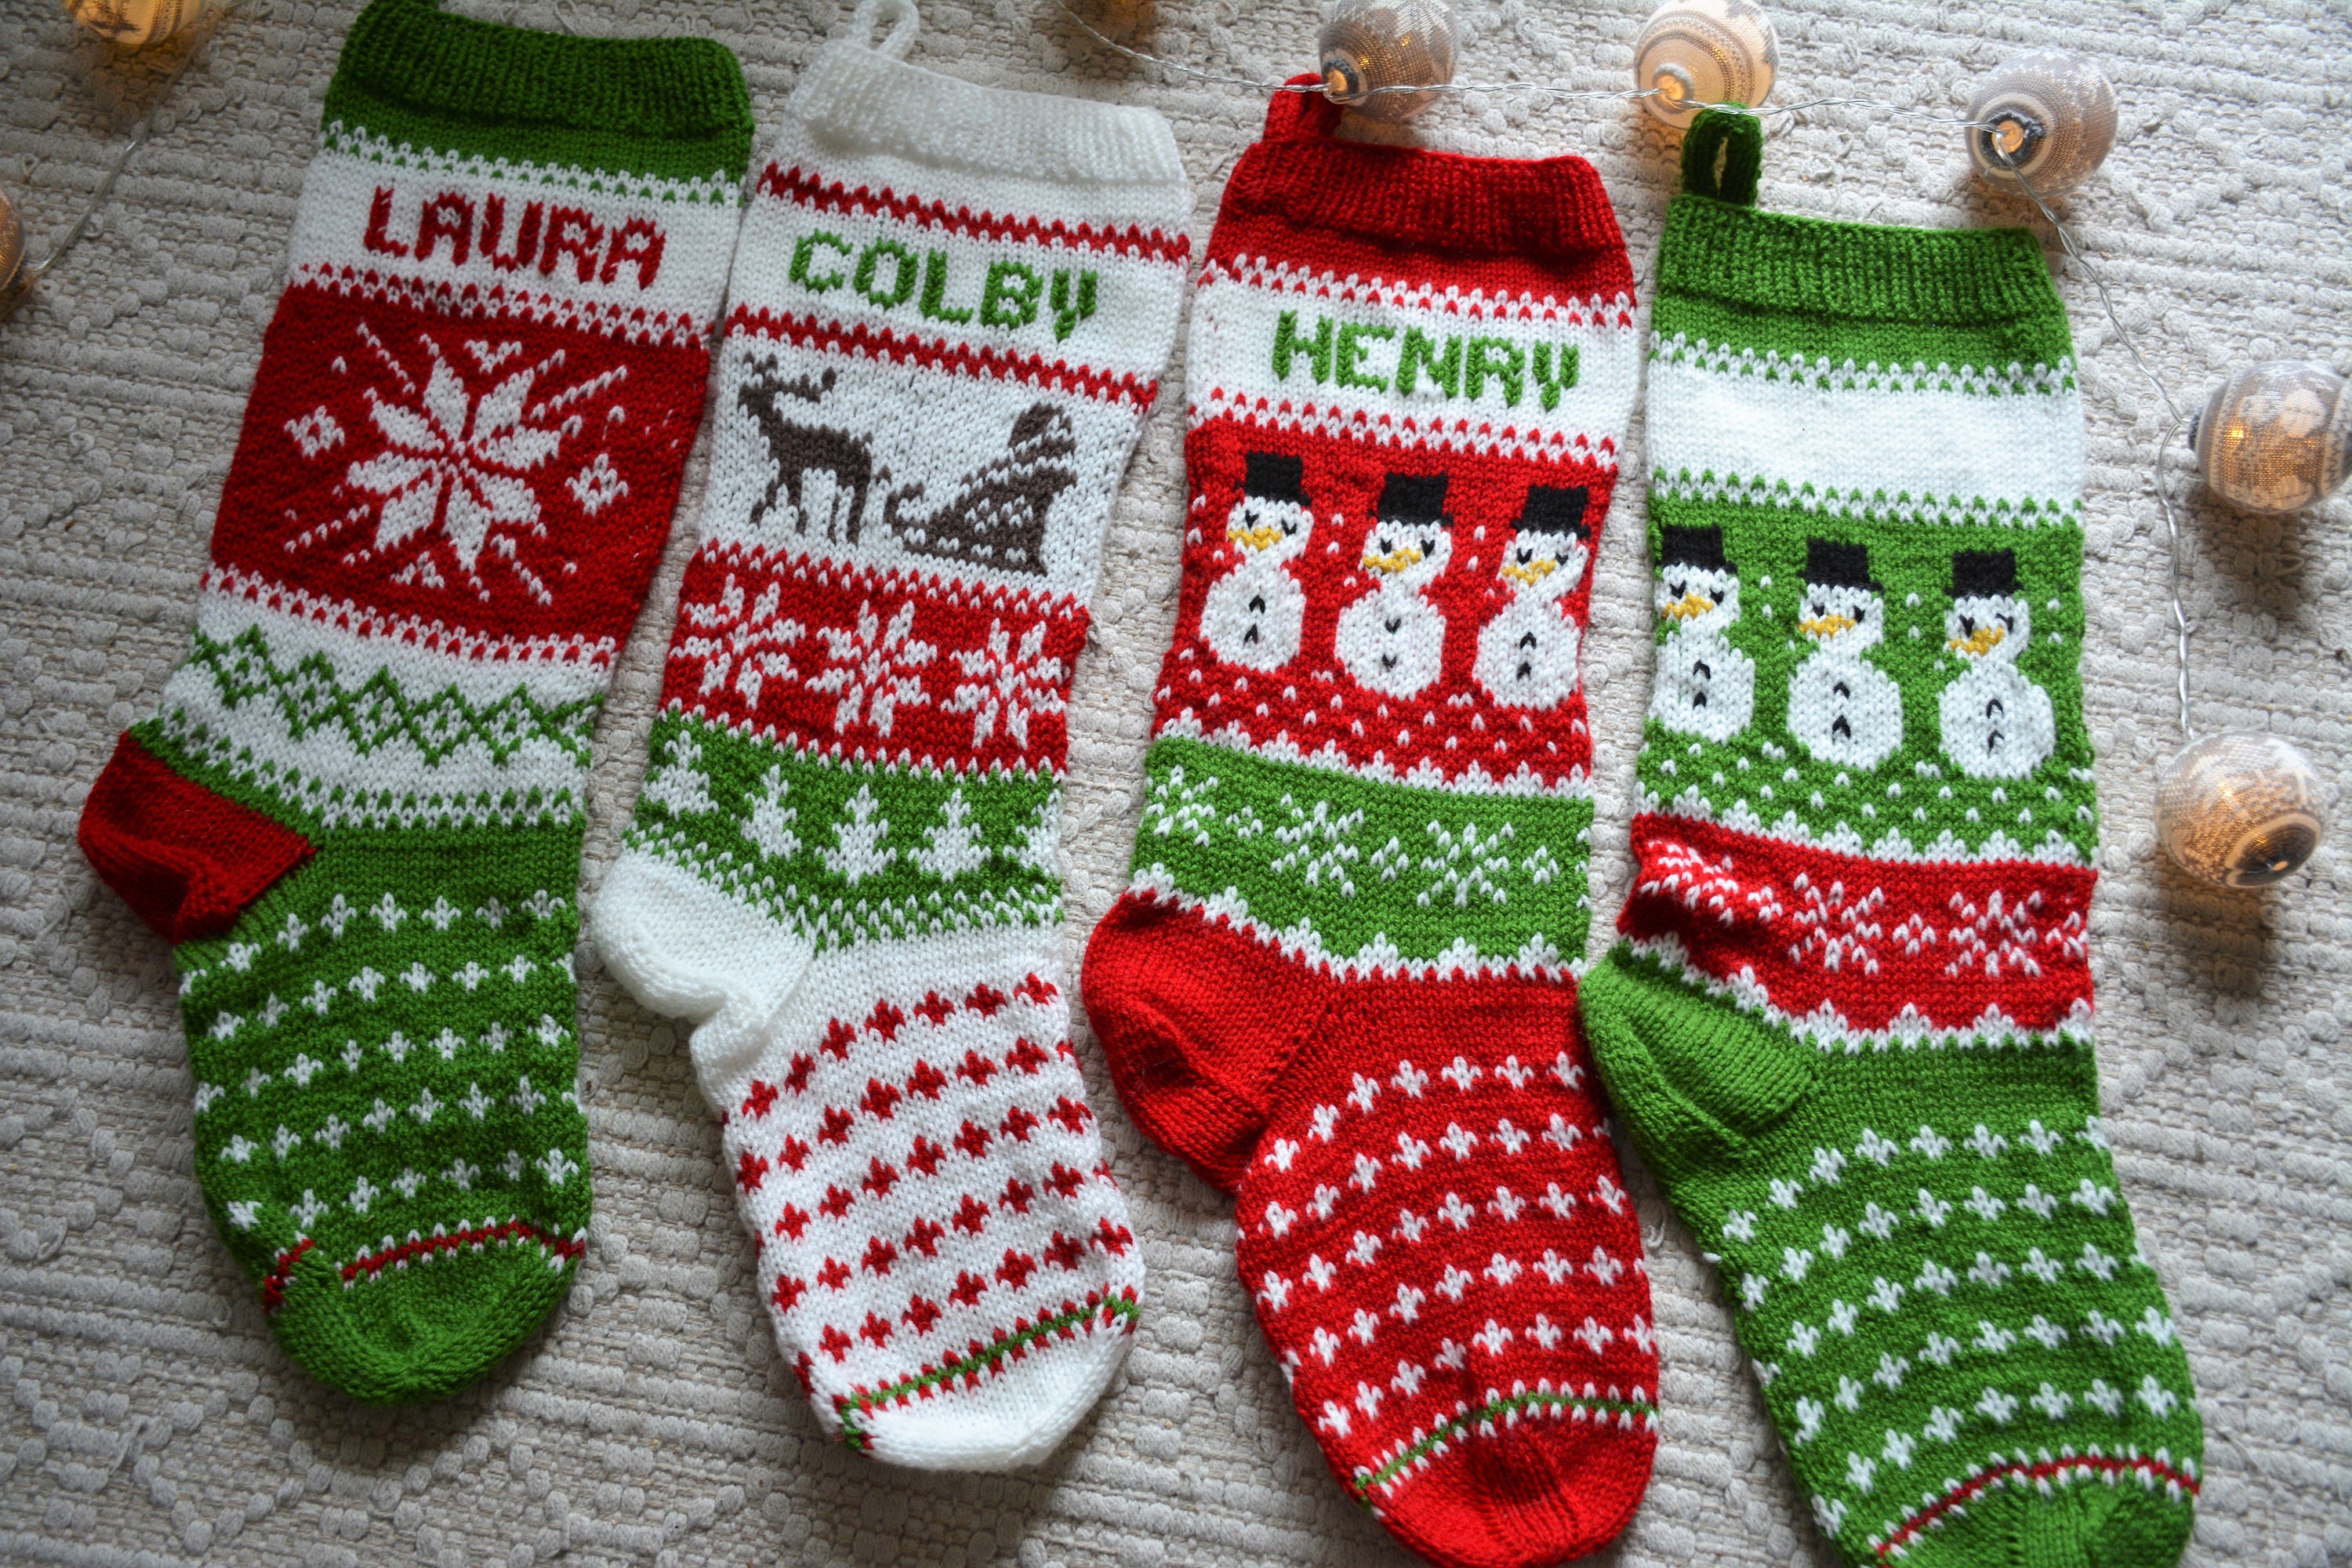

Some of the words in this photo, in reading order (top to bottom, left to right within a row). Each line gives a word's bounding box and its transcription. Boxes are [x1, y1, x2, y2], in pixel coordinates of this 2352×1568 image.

[364, 185, 666, 290] LAURA
[789, 228, 1098, 343] COLBY
[1272, 310, 1579, 412] HENRY
